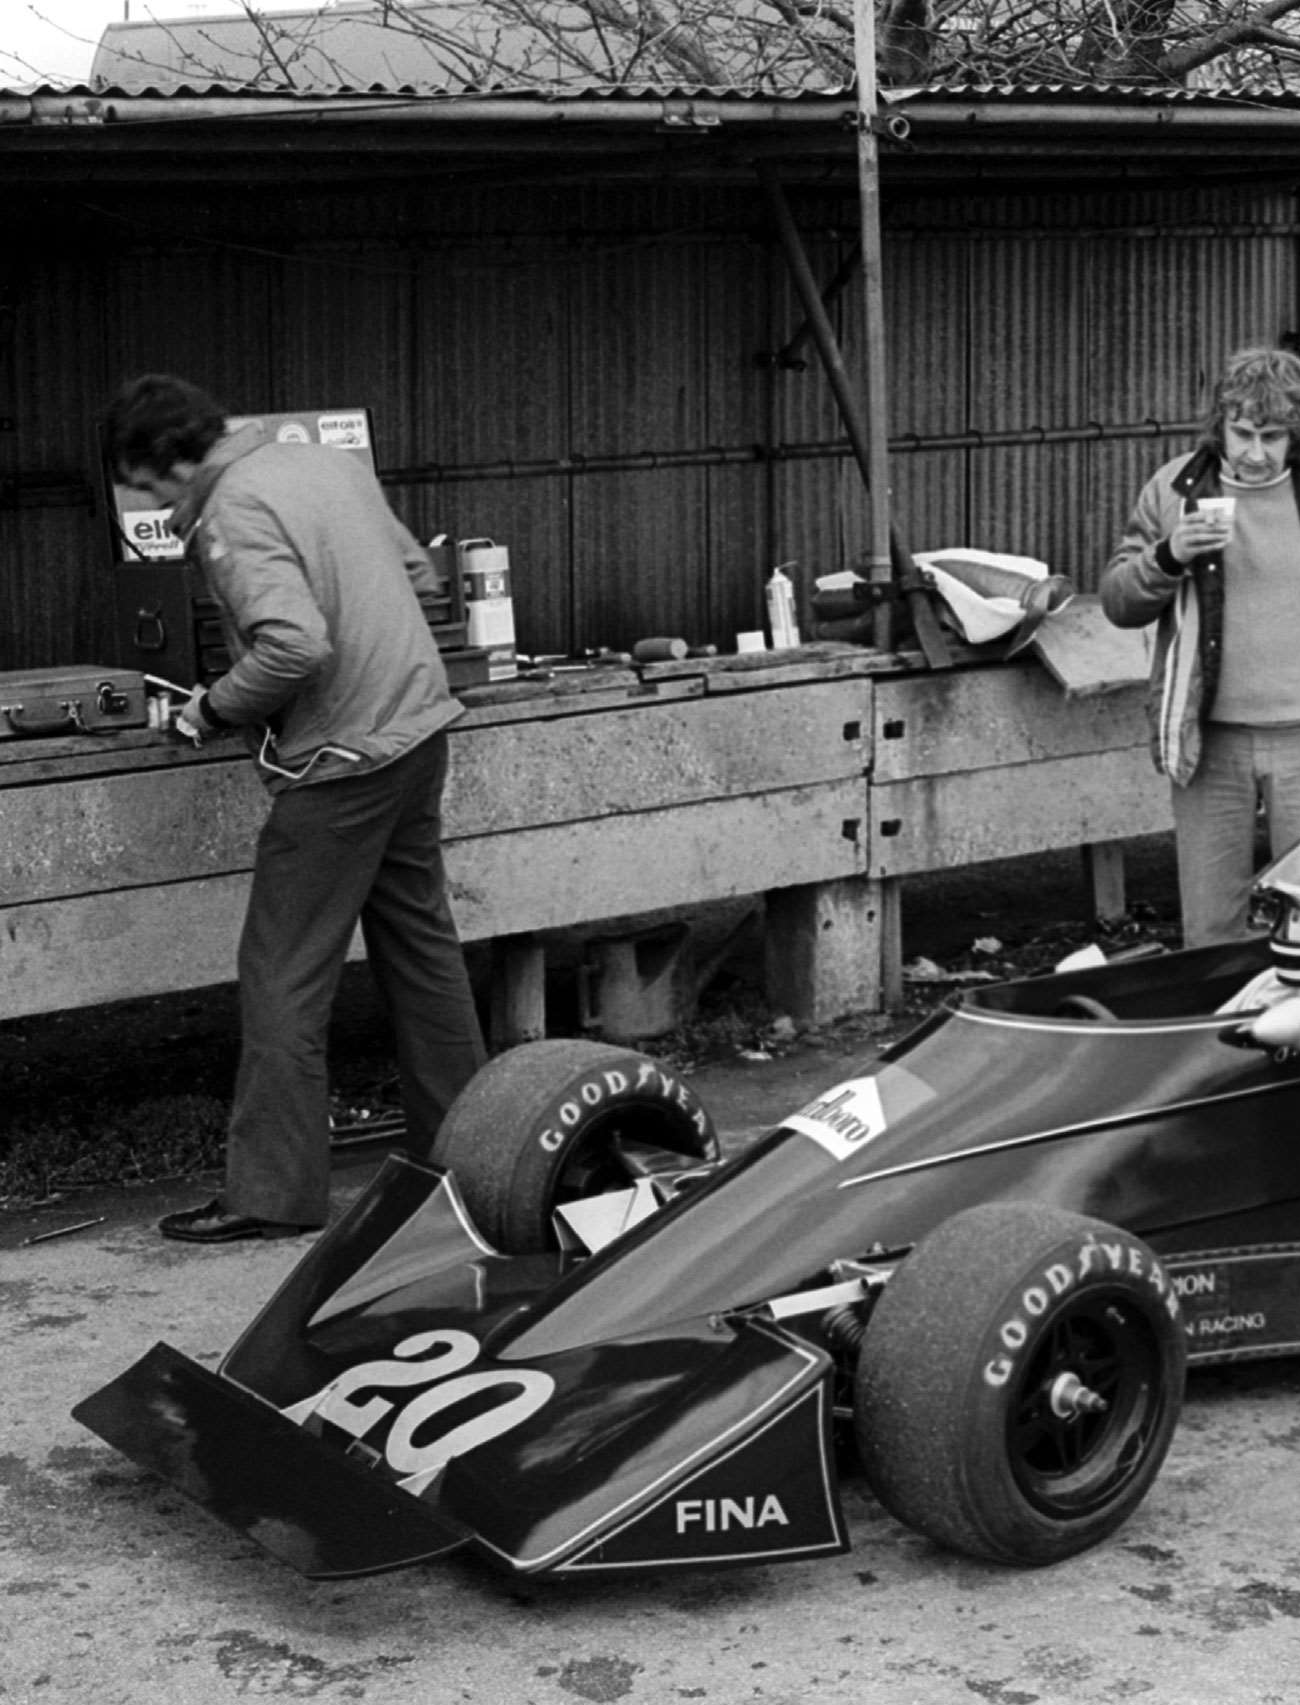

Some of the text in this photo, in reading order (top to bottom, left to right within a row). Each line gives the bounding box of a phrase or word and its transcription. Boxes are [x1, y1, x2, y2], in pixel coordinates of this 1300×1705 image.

[1199, 1312, 1266, 1336] RACING
[280, 1329, 556, 1474] 20
[676, 1494, 790, 1533] FINA
